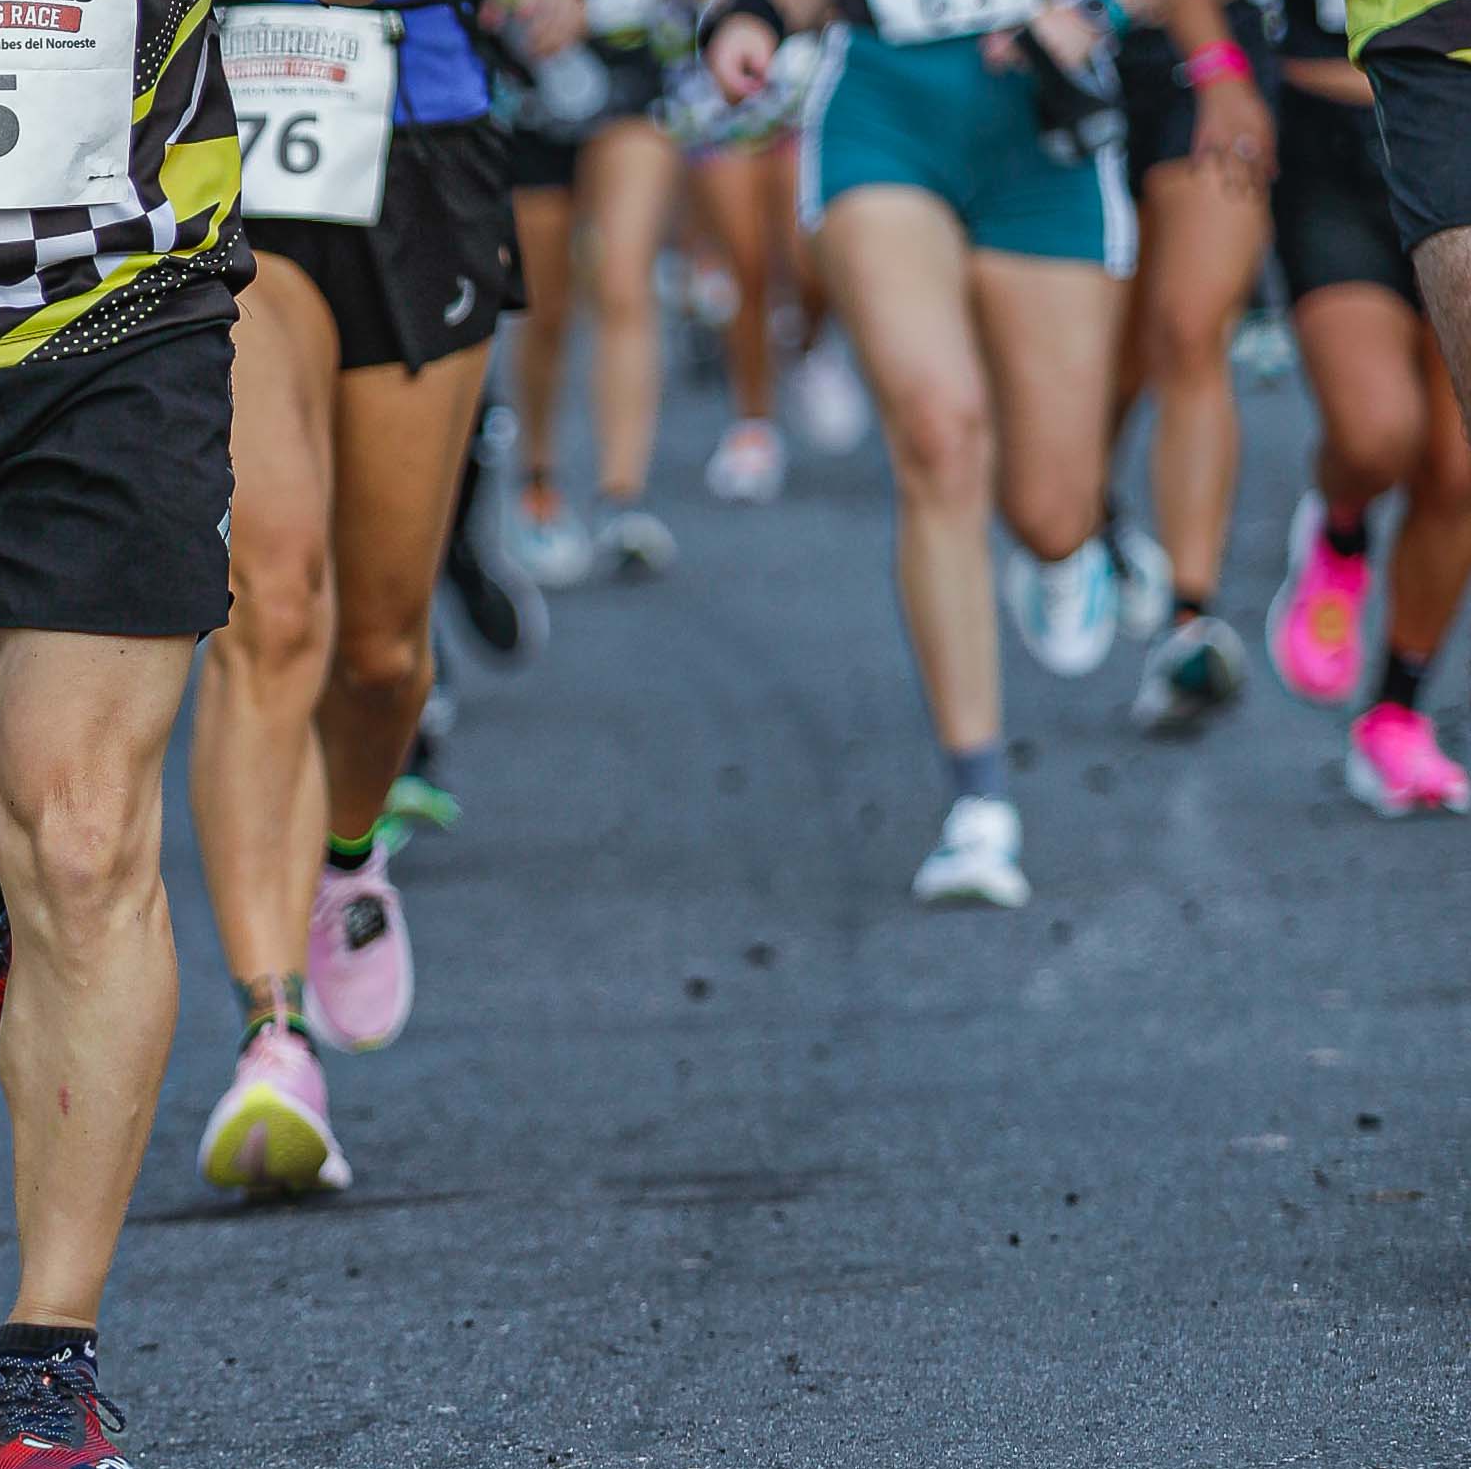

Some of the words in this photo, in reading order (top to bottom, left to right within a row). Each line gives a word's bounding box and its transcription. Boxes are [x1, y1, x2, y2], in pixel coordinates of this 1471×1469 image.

[11, 6, 61, 29] RACE
[25, 38, 43, 49] del
[45, 38, 96, 49] Noroeste
[237, 111, 320, 174] 76
